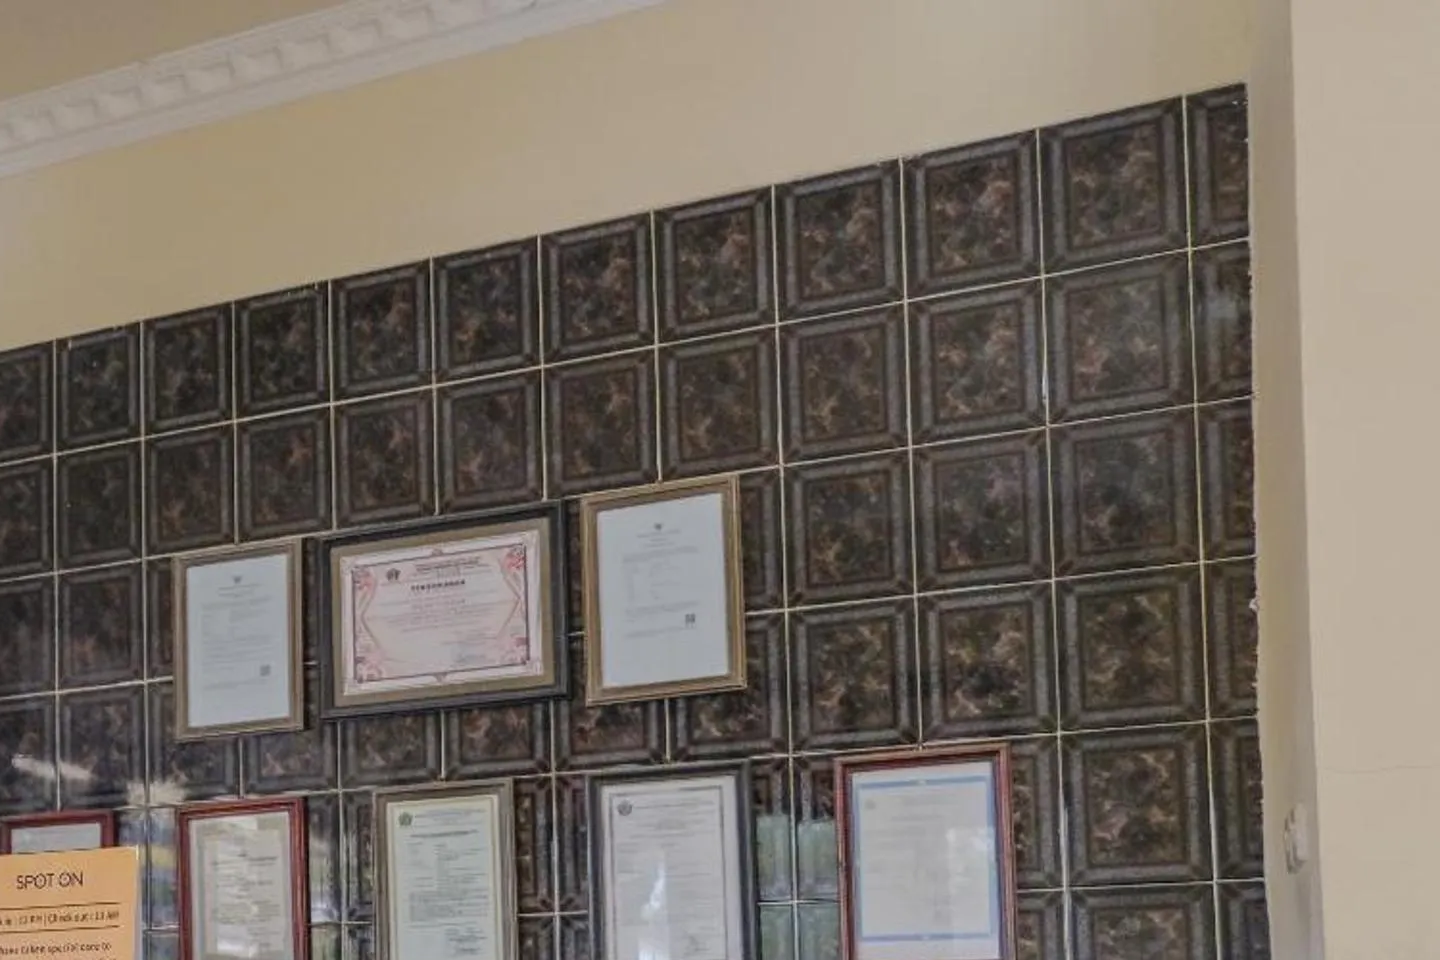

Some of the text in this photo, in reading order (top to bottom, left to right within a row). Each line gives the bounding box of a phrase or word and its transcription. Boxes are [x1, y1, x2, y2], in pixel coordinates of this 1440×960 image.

[16, 870, 84, 890] SPOT ON
[20, 944, 46, 955] taken
[47, 942, 77, 956] special
